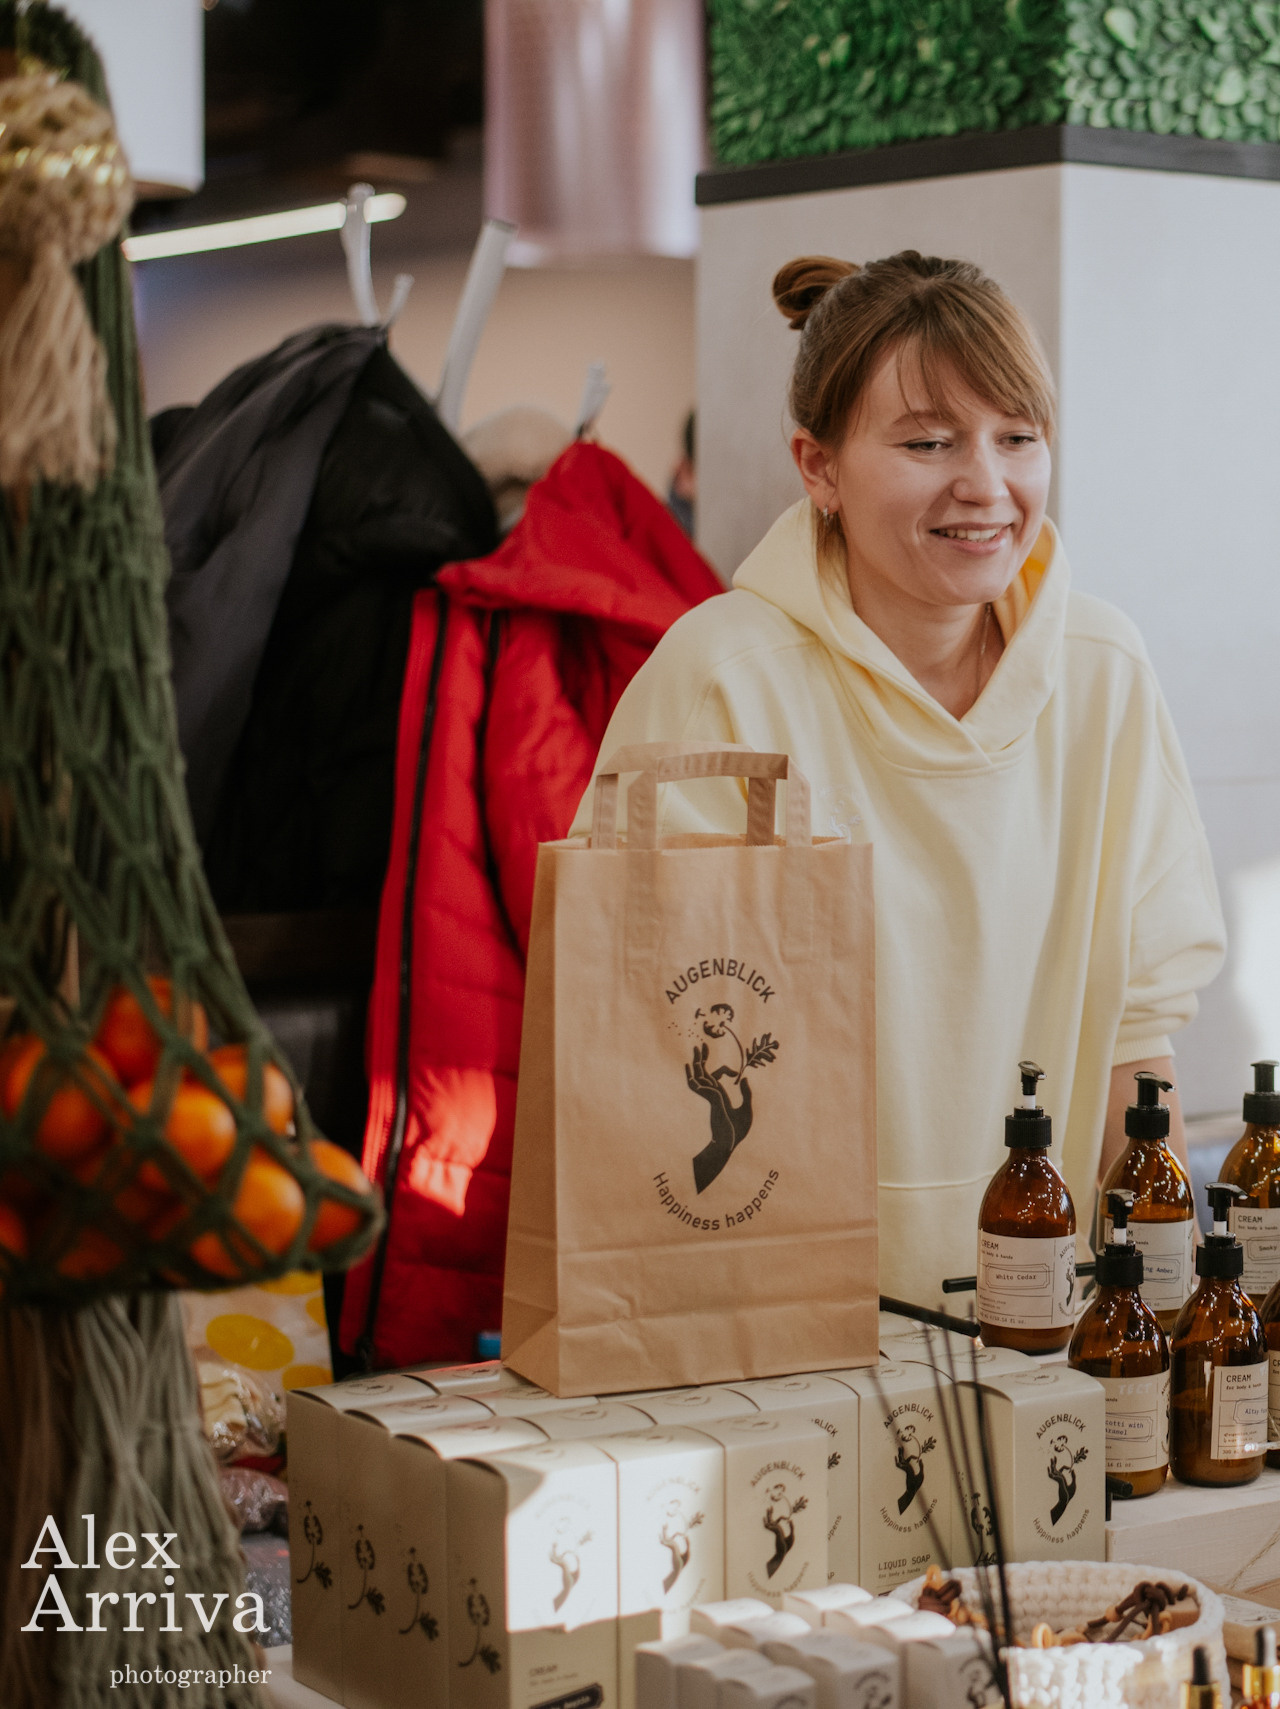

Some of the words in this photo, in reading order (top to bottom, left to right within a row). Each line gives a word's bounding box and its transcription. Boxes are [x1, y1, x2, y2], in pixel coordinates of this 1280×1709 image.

[664, 957, 776, 1006] AUGENBLICK
[652, 1171, 720, 1231] Happiness
[724, 1168, 780, 1229] happens
[1238, 1215, 1263, 1223] CREAM
[1226, 1374, 1252, 1383] CREAM
[883, 1403, 935, 1429] AUGENBLICK
[1035, 1413, 1086, 1440] AUGENBLICK
[1105, 1420, 1125, 1428] cotti
[1105, 1428, 1128, 1436] aramel
[750, 1460, 806, 1488] AUGENBLICK
[879, 1506, 912, 1533] Happiness
[914, 1498, 938, 1530] happens
[1033, 1517, 1064, 1544] Happiness
[1066, 1508, 1089, 1540] happens
[878, 1558, 907, 1571] LIQUID
[912, 1554, 931, 1565] SOAP
